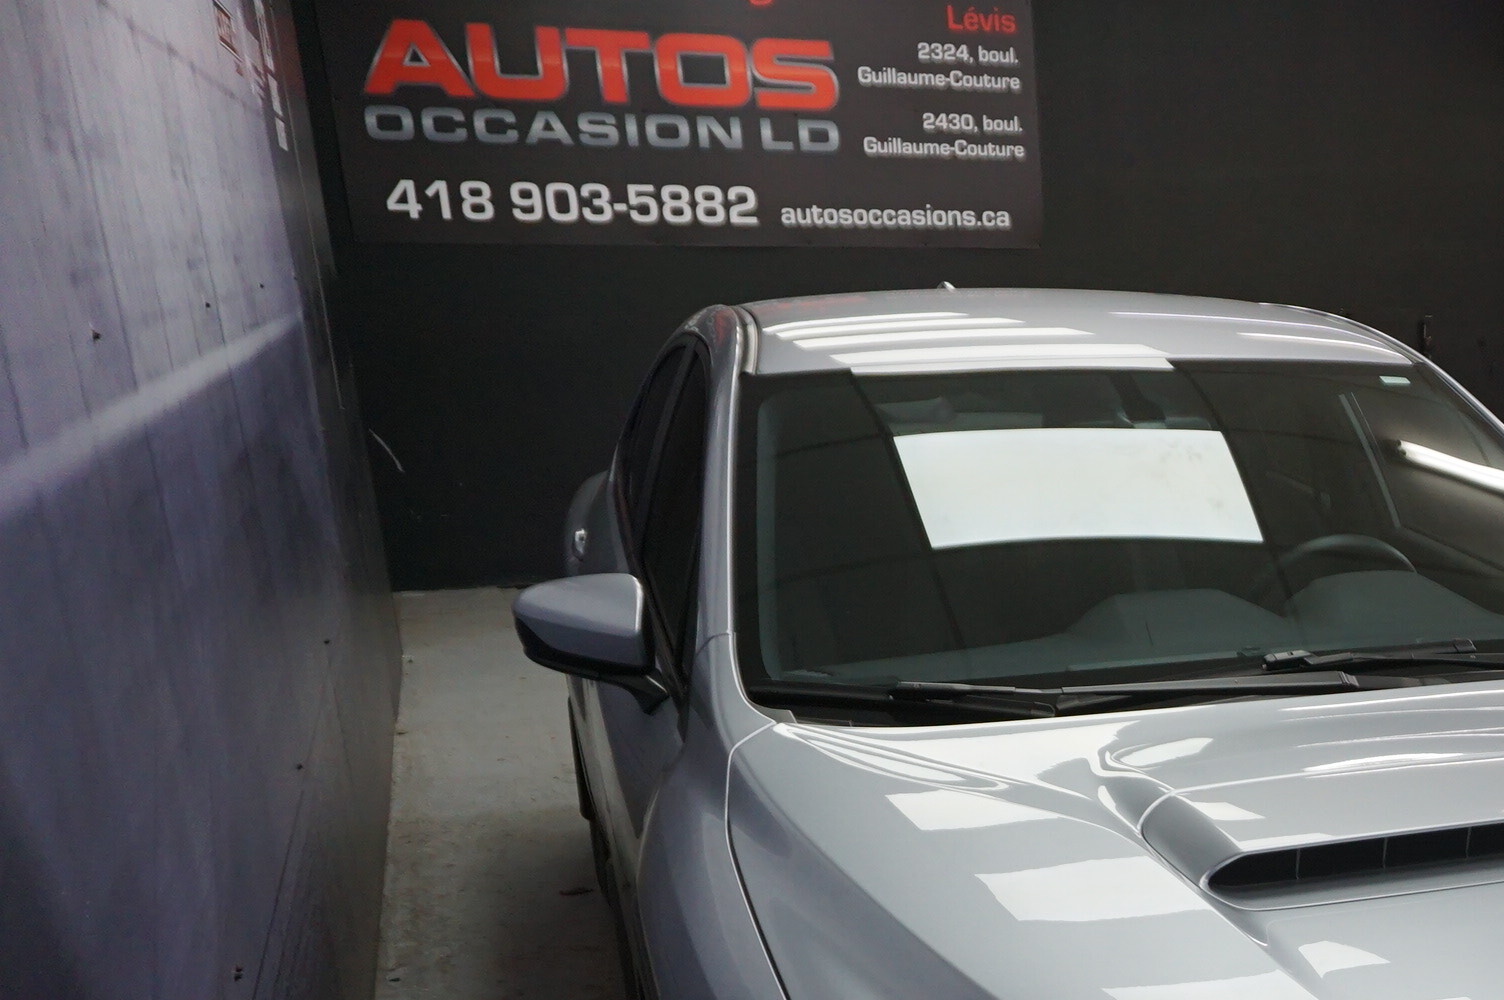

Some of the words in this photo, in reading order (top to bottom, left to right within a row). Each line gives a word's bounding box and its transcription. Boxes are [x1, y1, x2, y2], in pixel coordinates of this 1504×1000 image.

[946, 5, 1017, 33] Lévis
[363, 19, 840, 112] AUTOS
[917, 42, 974, 64] 2324,
[978, 45, 1019, 64] boul.
[857, 66, 1021, 92] Guillaume-Couture
[363, 104, 743, 150] OCCASION
[760, 117, 840, 152] LD
[922, 112, 978, 134] 2430,
[982, 116, 1023, 134] boul.
[863, 136, 1025, 160] Guillaume-Couture
[386, 178, 495, 222] 418
[509, 181, 760, 227] 903-5882
[780, 203, 1012, 230] autosoccasions.ca
